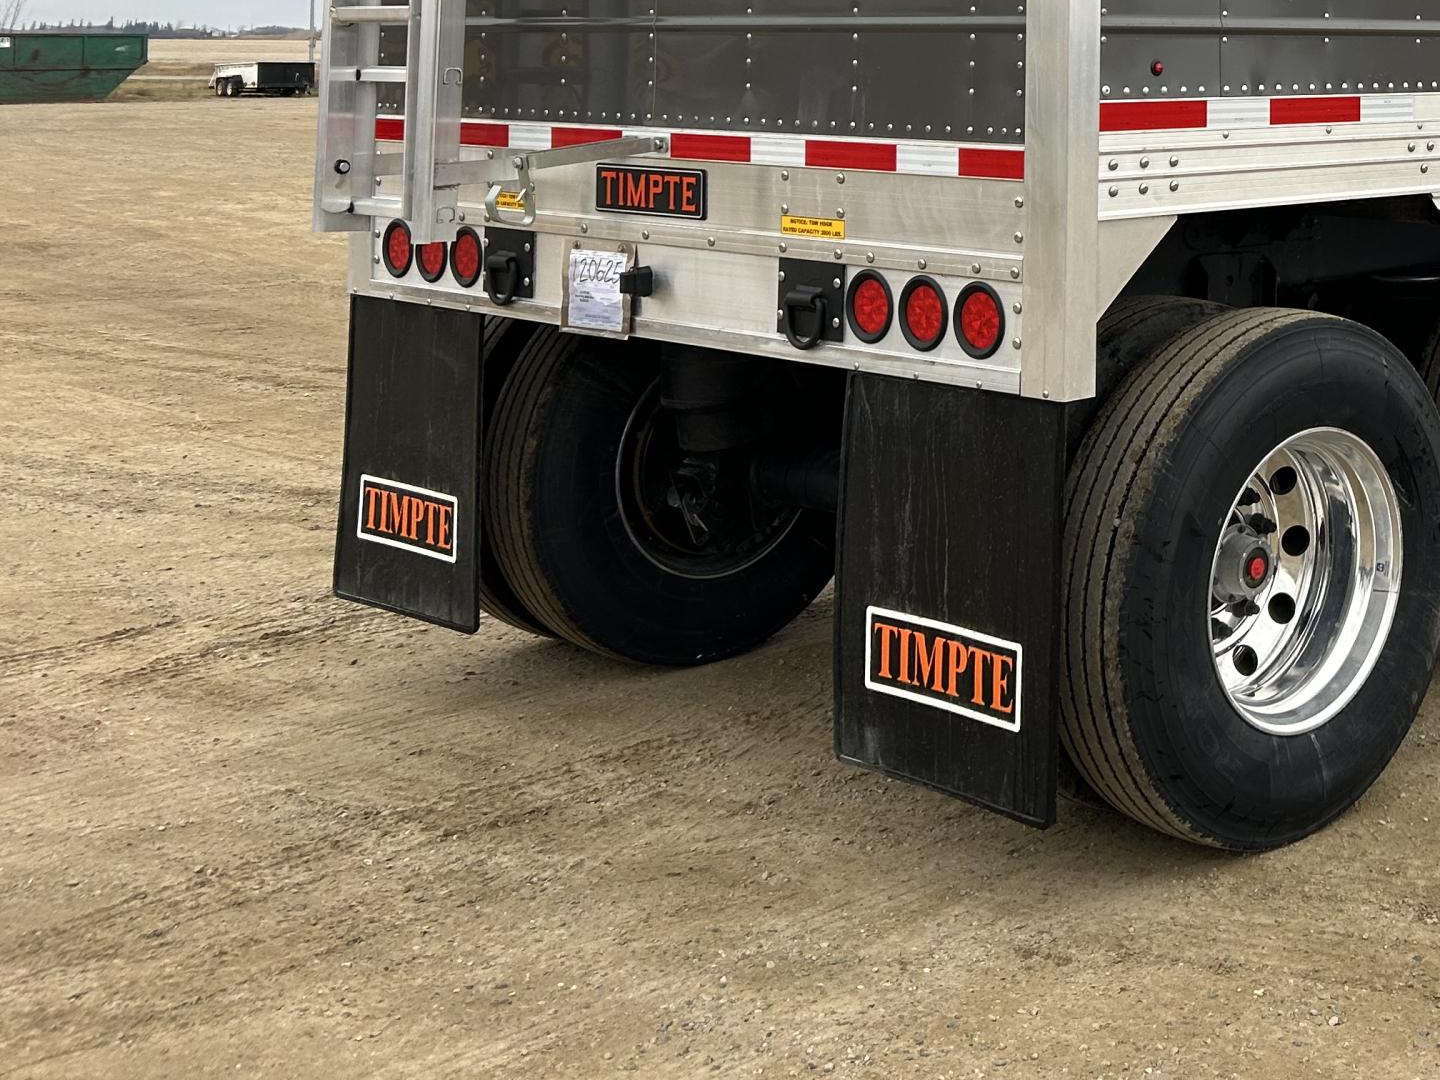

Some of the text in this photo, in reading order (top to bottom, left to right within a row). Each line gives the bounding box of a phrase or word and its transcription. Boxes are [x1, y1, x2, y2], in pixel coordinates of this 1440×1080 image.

[601, 171, 696, 211] TIMPTE
[573, 258, 622, 284] 120625
[365, 486, 452, 550] TIMPTE
[874, 622, 1013, 714] TIMPTE
